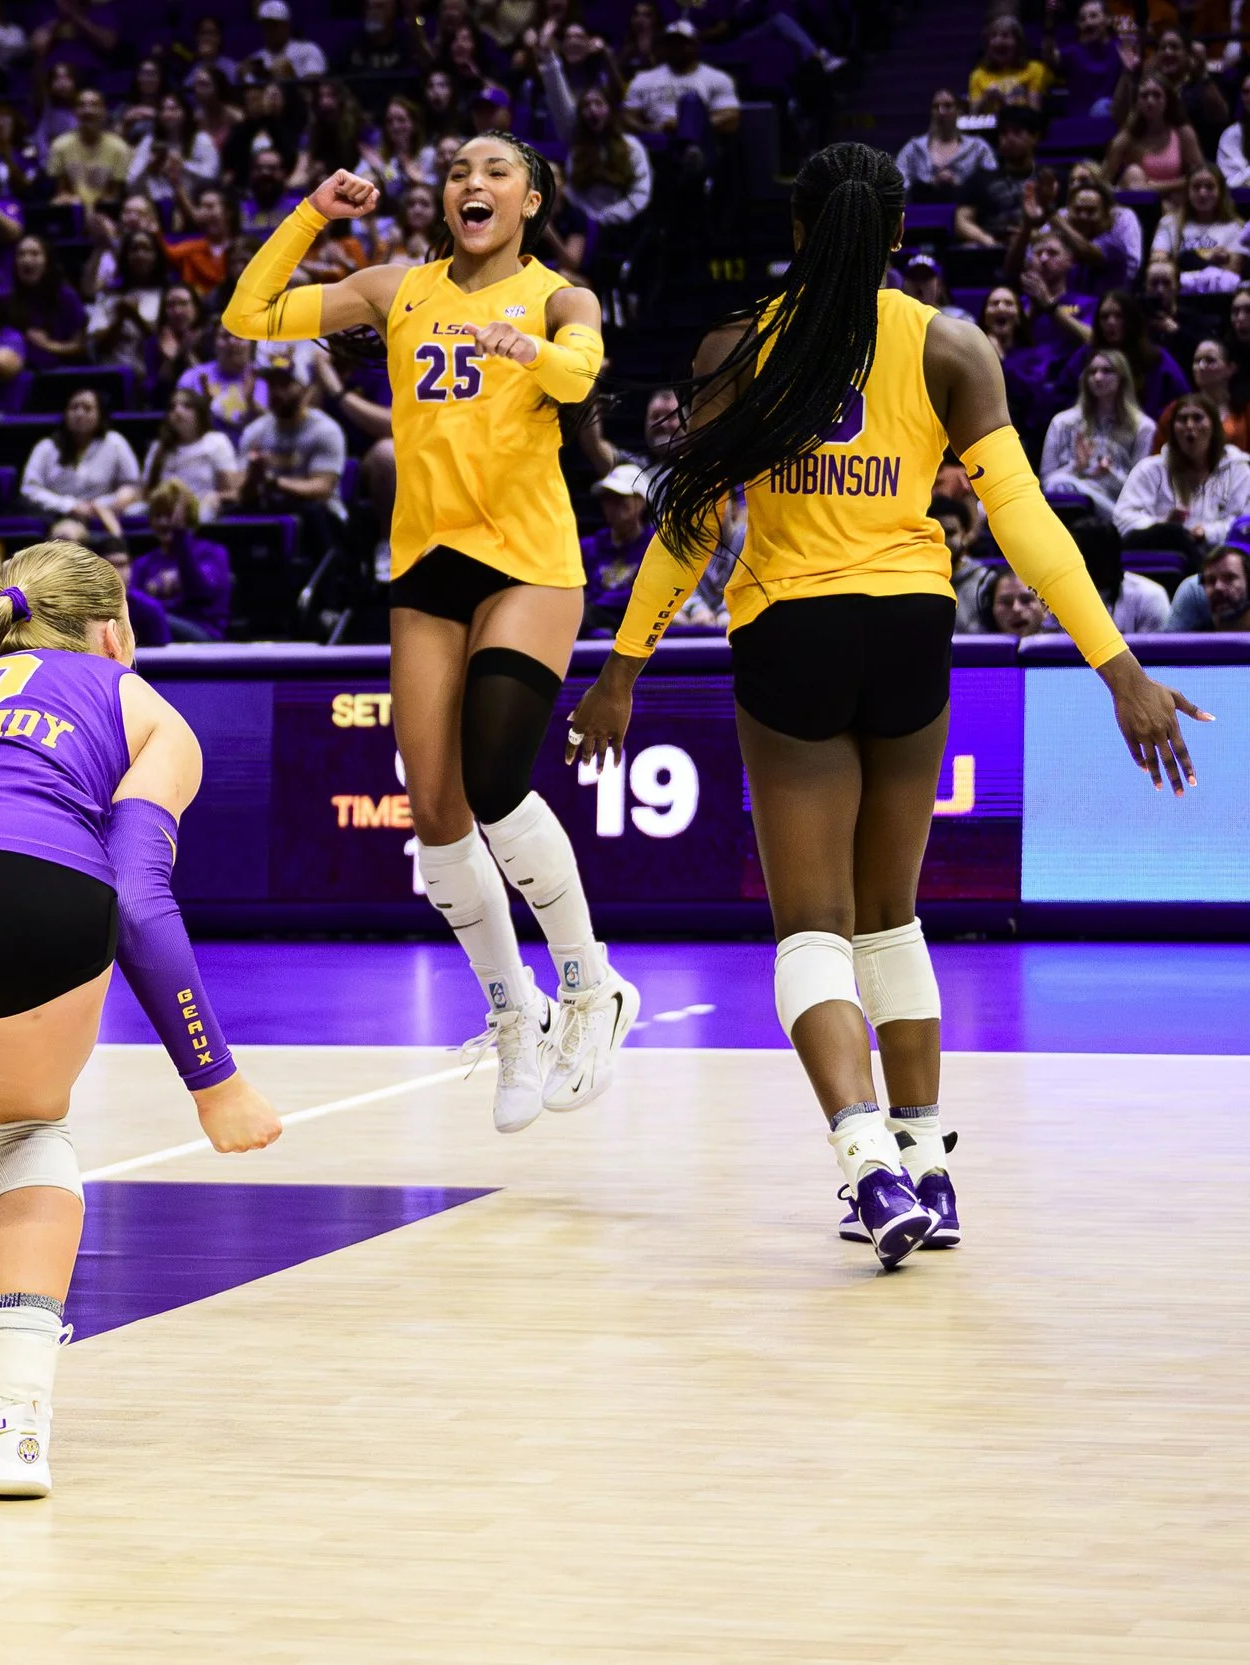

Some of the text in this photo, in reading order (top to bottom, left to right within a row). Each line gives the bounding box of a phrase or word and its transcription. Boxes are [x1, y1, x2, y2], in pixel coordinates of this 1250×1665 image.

[414, 342, 487, 402] 25
[577, 744, 700, 838] 19
[176, 988, 213, 1066] GEAUX
